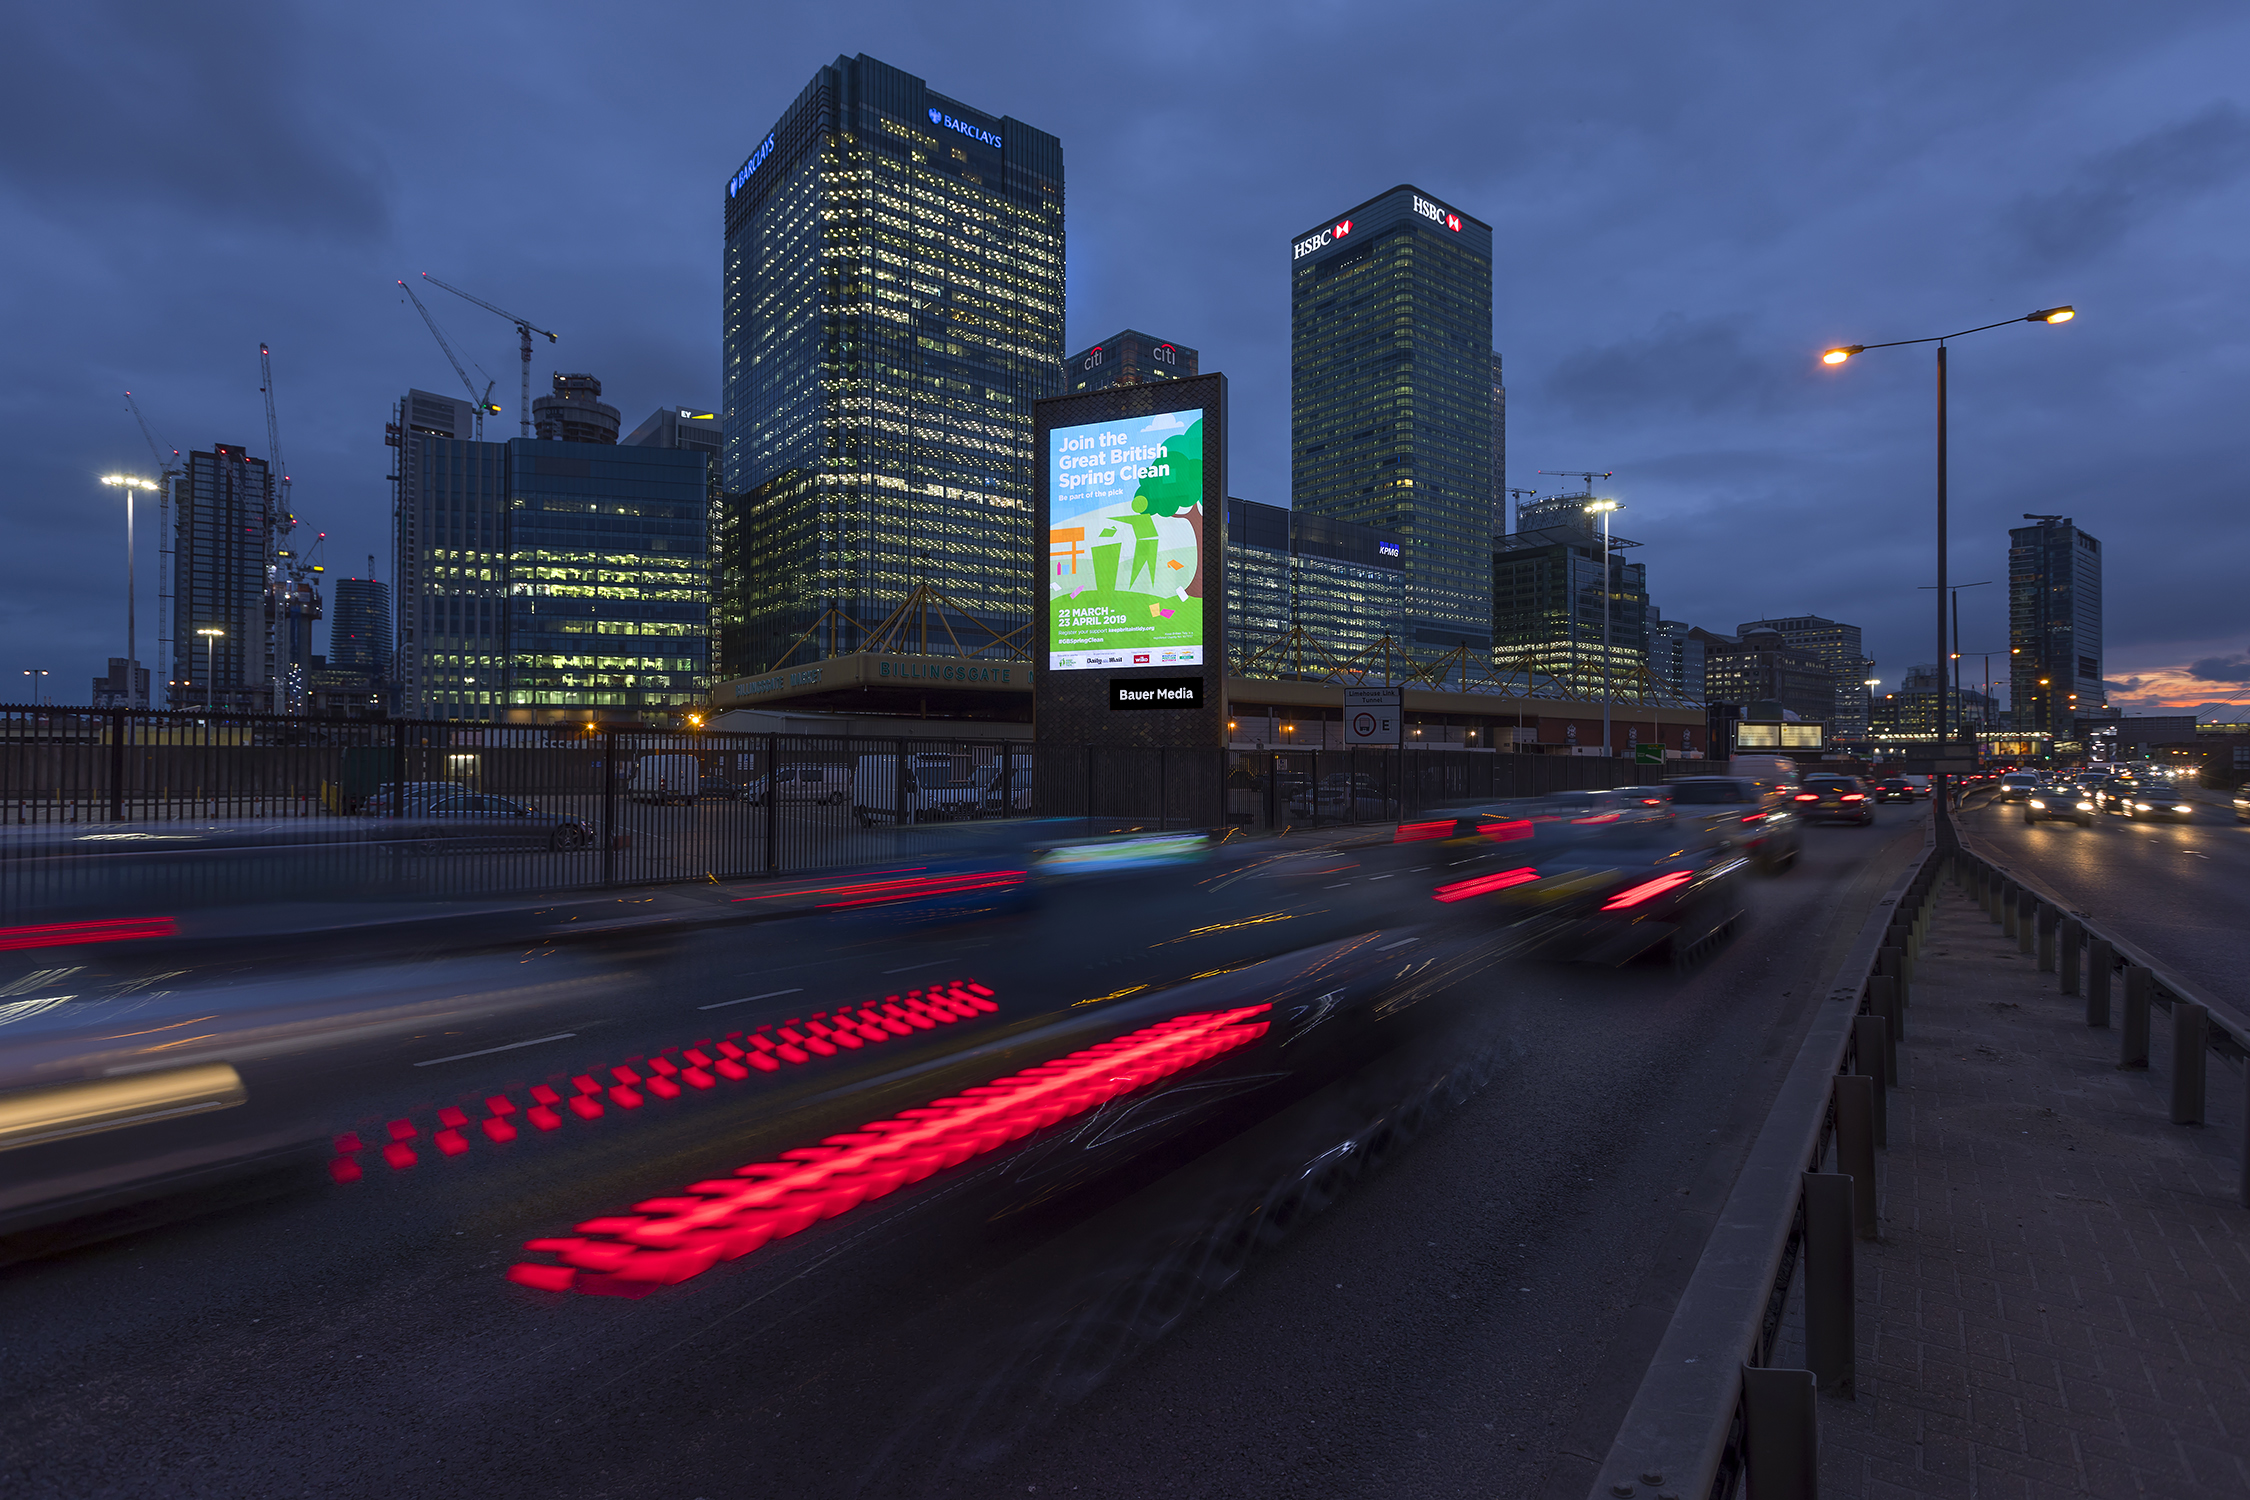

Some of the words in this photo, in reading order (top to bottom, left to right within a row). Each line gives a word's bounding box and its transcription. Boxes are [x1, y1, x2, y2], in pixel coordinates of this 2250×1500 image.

[943, 116, 1002, 148] BARCLAYS
[738, 133, 774, 189] BARCLAYS
[1413, 195, 1446, 225] HSBC
[1294, 229, 1332, 260] HSBC
[1084, 350, 1102, 371] citi
[1153, 346, 1175, 365] citi
[681, 410, 691, 418] EY
[1059, 435, 1094, 452] Join
[1099, 432, 1127, 447] the
[1059, 451, 1106, 469] Great
[1111, 443, 1168, 464] British
[1059, 470, 1115, 489] Spring
[1120, 464, 1170, 481] Clean
[1069, 493, 1084, 501] part
[1108, 488, 1124, 496] pick
[1379, 546, 1399, 557] KPMG
[1058, 609, 1071, 617] 22
[1072, 607, 1109, 617] MARCH
[1058, 618, 1071, 627] 23
[1072, 617, 1101, 626] APRIL
[1103, 615, 1127, 625] 2019
[879, 661, 1011, 683] BILLINGSGATE
[735, 676, 784, 697] BILLINGSGATE
[790, 668, 823, 687] MARKET
[1119, 689, 1154, 700] Bauer
[1157, 687, 1193, 699] Media
[1382, 720, 1390, 731] E
